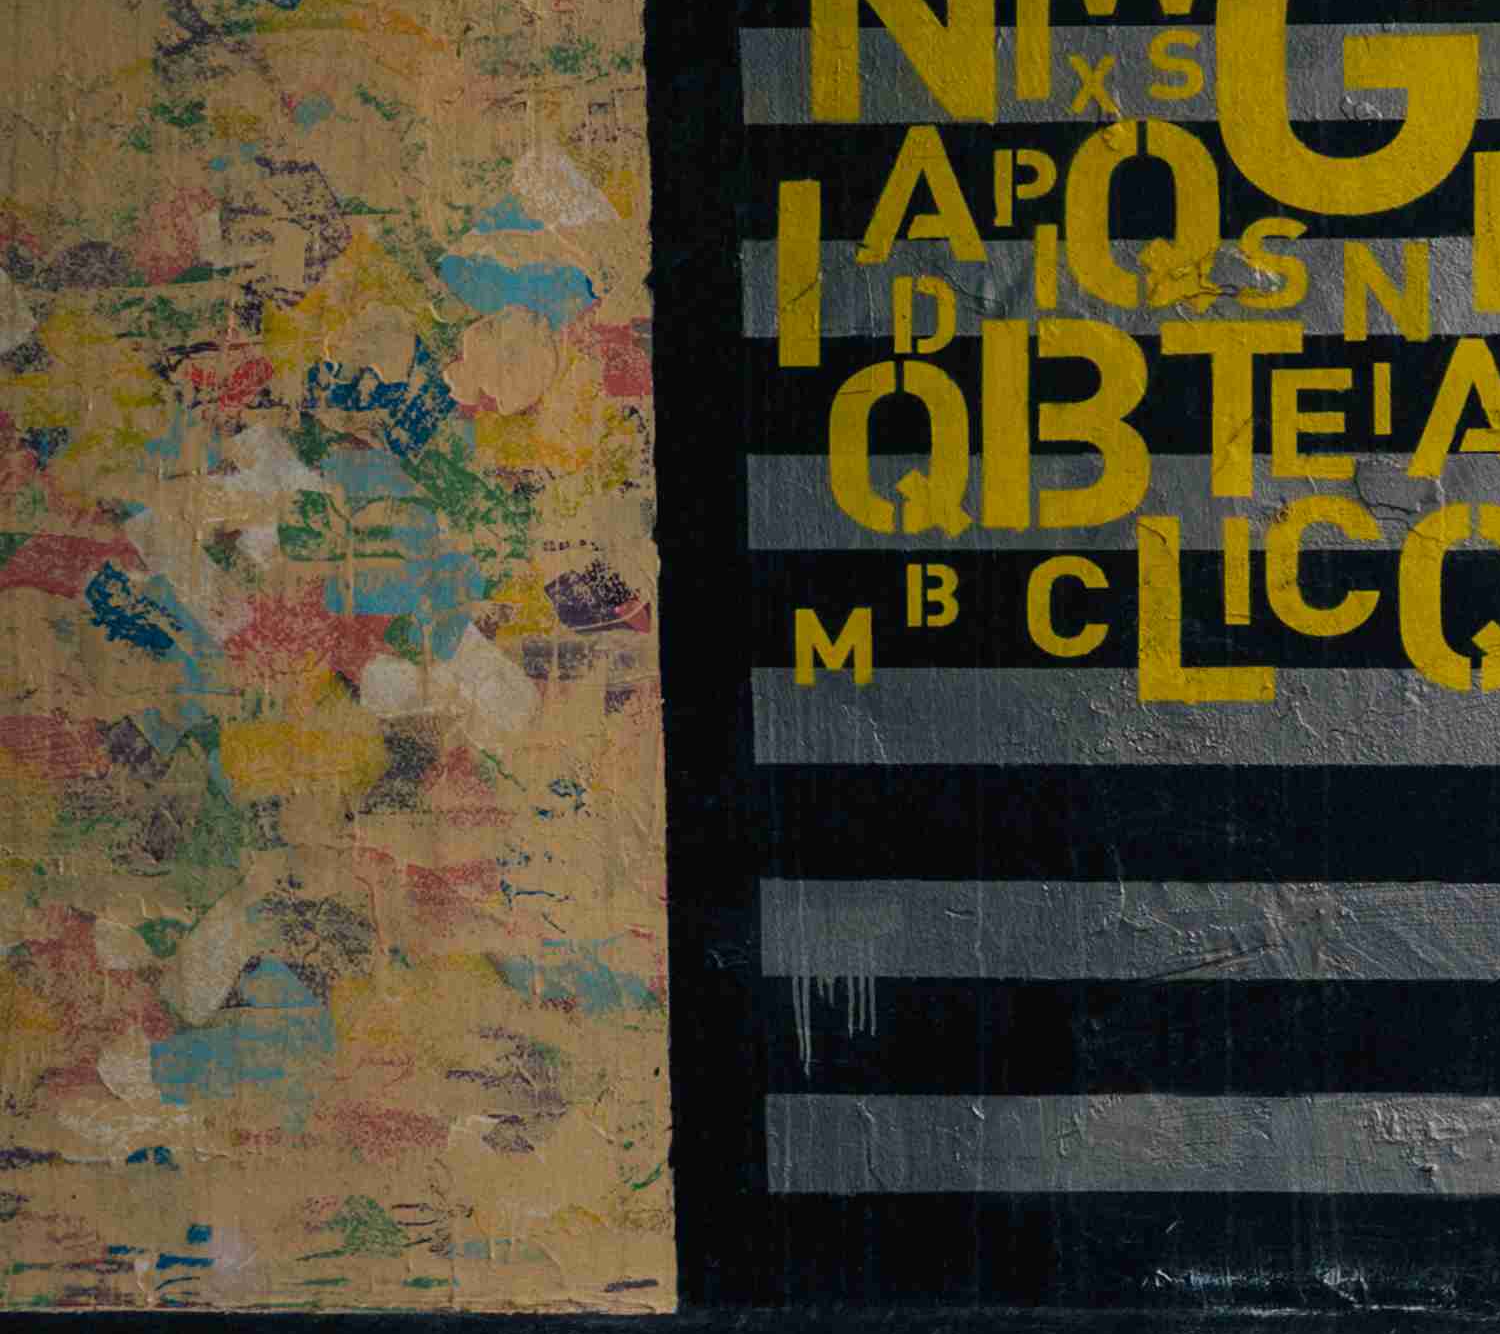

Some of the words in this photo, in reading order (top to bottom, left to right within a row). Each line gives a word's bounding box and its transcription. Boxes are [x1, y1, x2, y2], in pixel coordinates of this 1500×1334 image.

[1069, 53, 1119, 115] X
[1147, 29, 1205, 100] S
[855, 126, 987, 264] A
[994, 149, 1057, 226] P
[1064, 117, 1223, 315] Q
[1236, 218, 1309, 311] S
[1344, 241, 1430, 342] N
[891, 276, 956, 354] D
[828, 361, 972, 538] Q
[981, 316, 1152, 532] B
[1159, 319, 1305, 498] T
[1270, 368, 1355, 481] E
[795, 608, 873, 686] M
[907, 564, 958, 627] B
[1027, 556, 1108, 657] C
[1136, 514, 1276, 705] L
[1265, 494, 1381, 636] C
